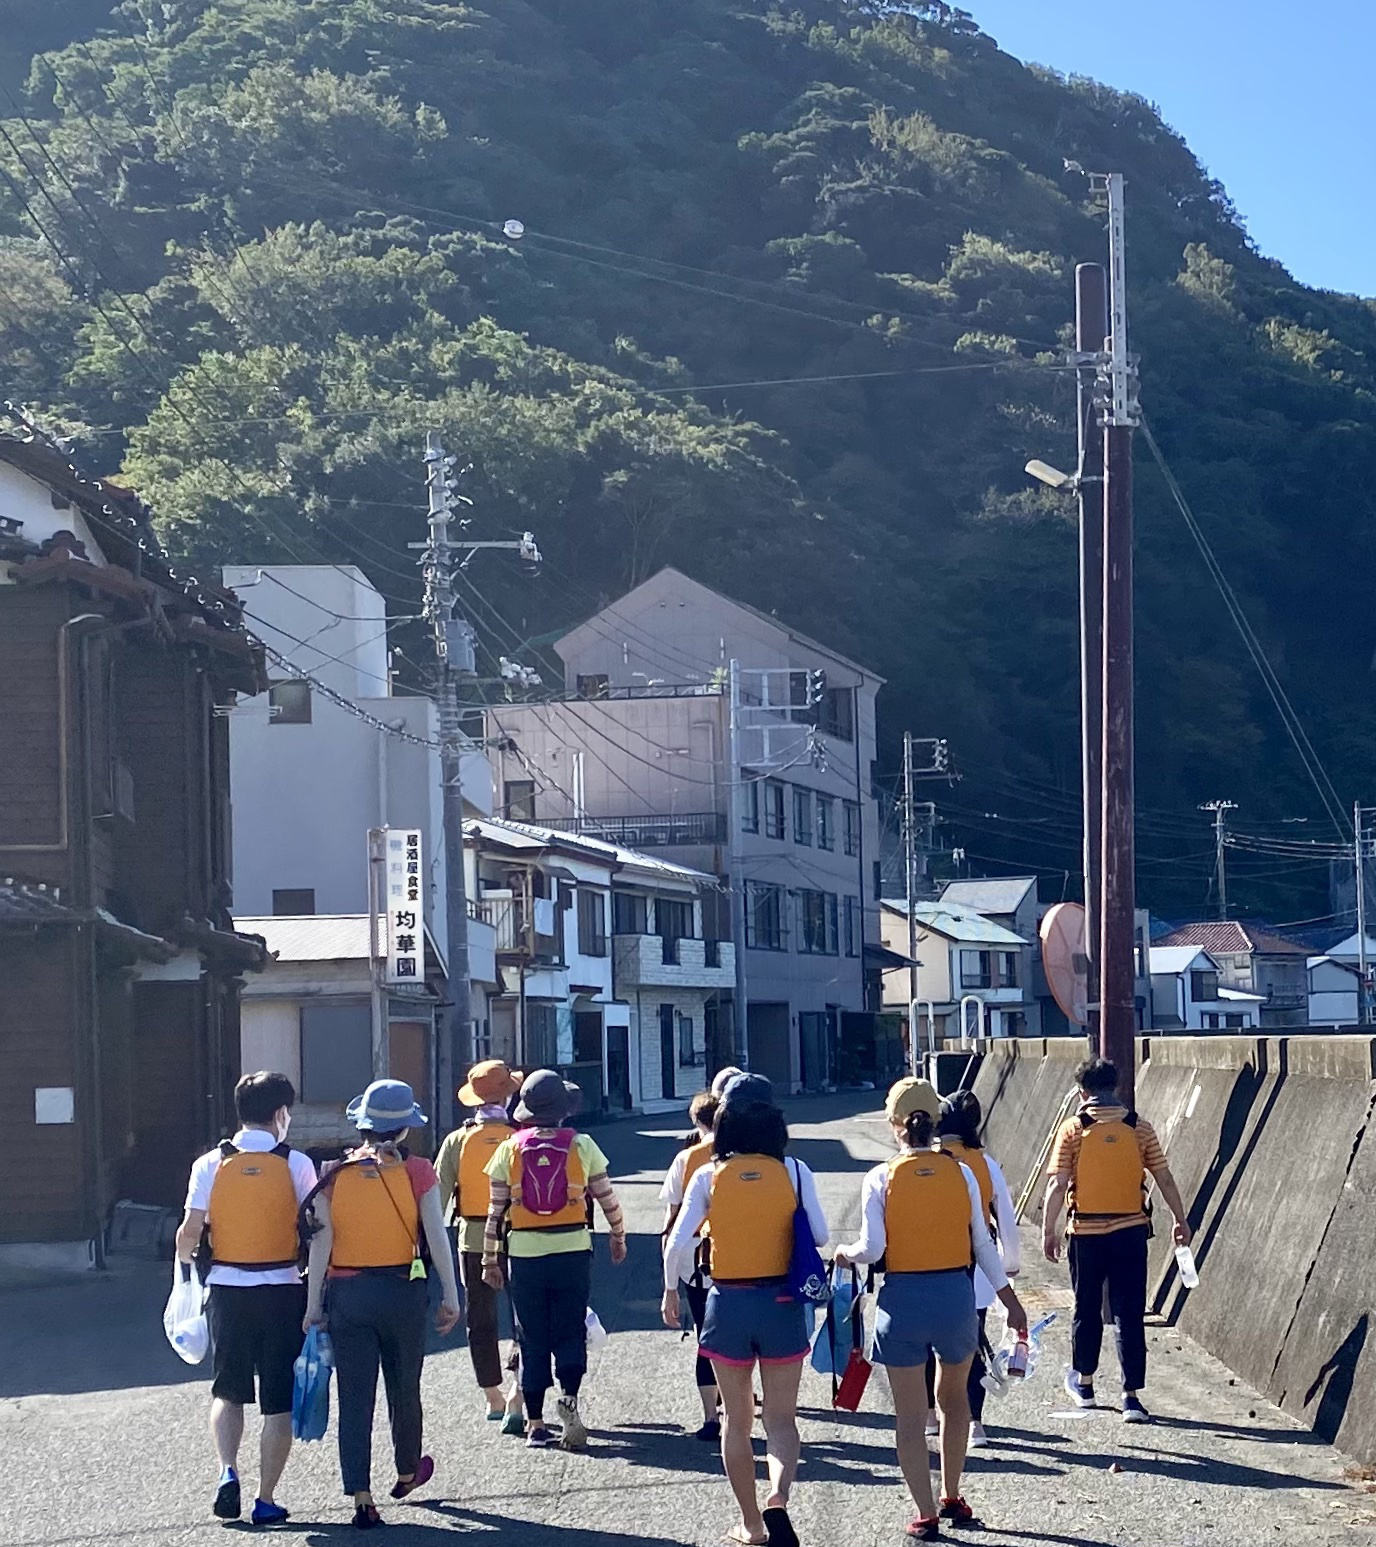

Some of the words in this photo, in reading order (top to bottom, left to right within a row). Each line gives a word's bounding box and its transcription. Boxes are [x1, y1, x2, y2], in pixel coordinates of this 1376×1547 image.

[406, 834, 418, 901] 居酒屋食堂
